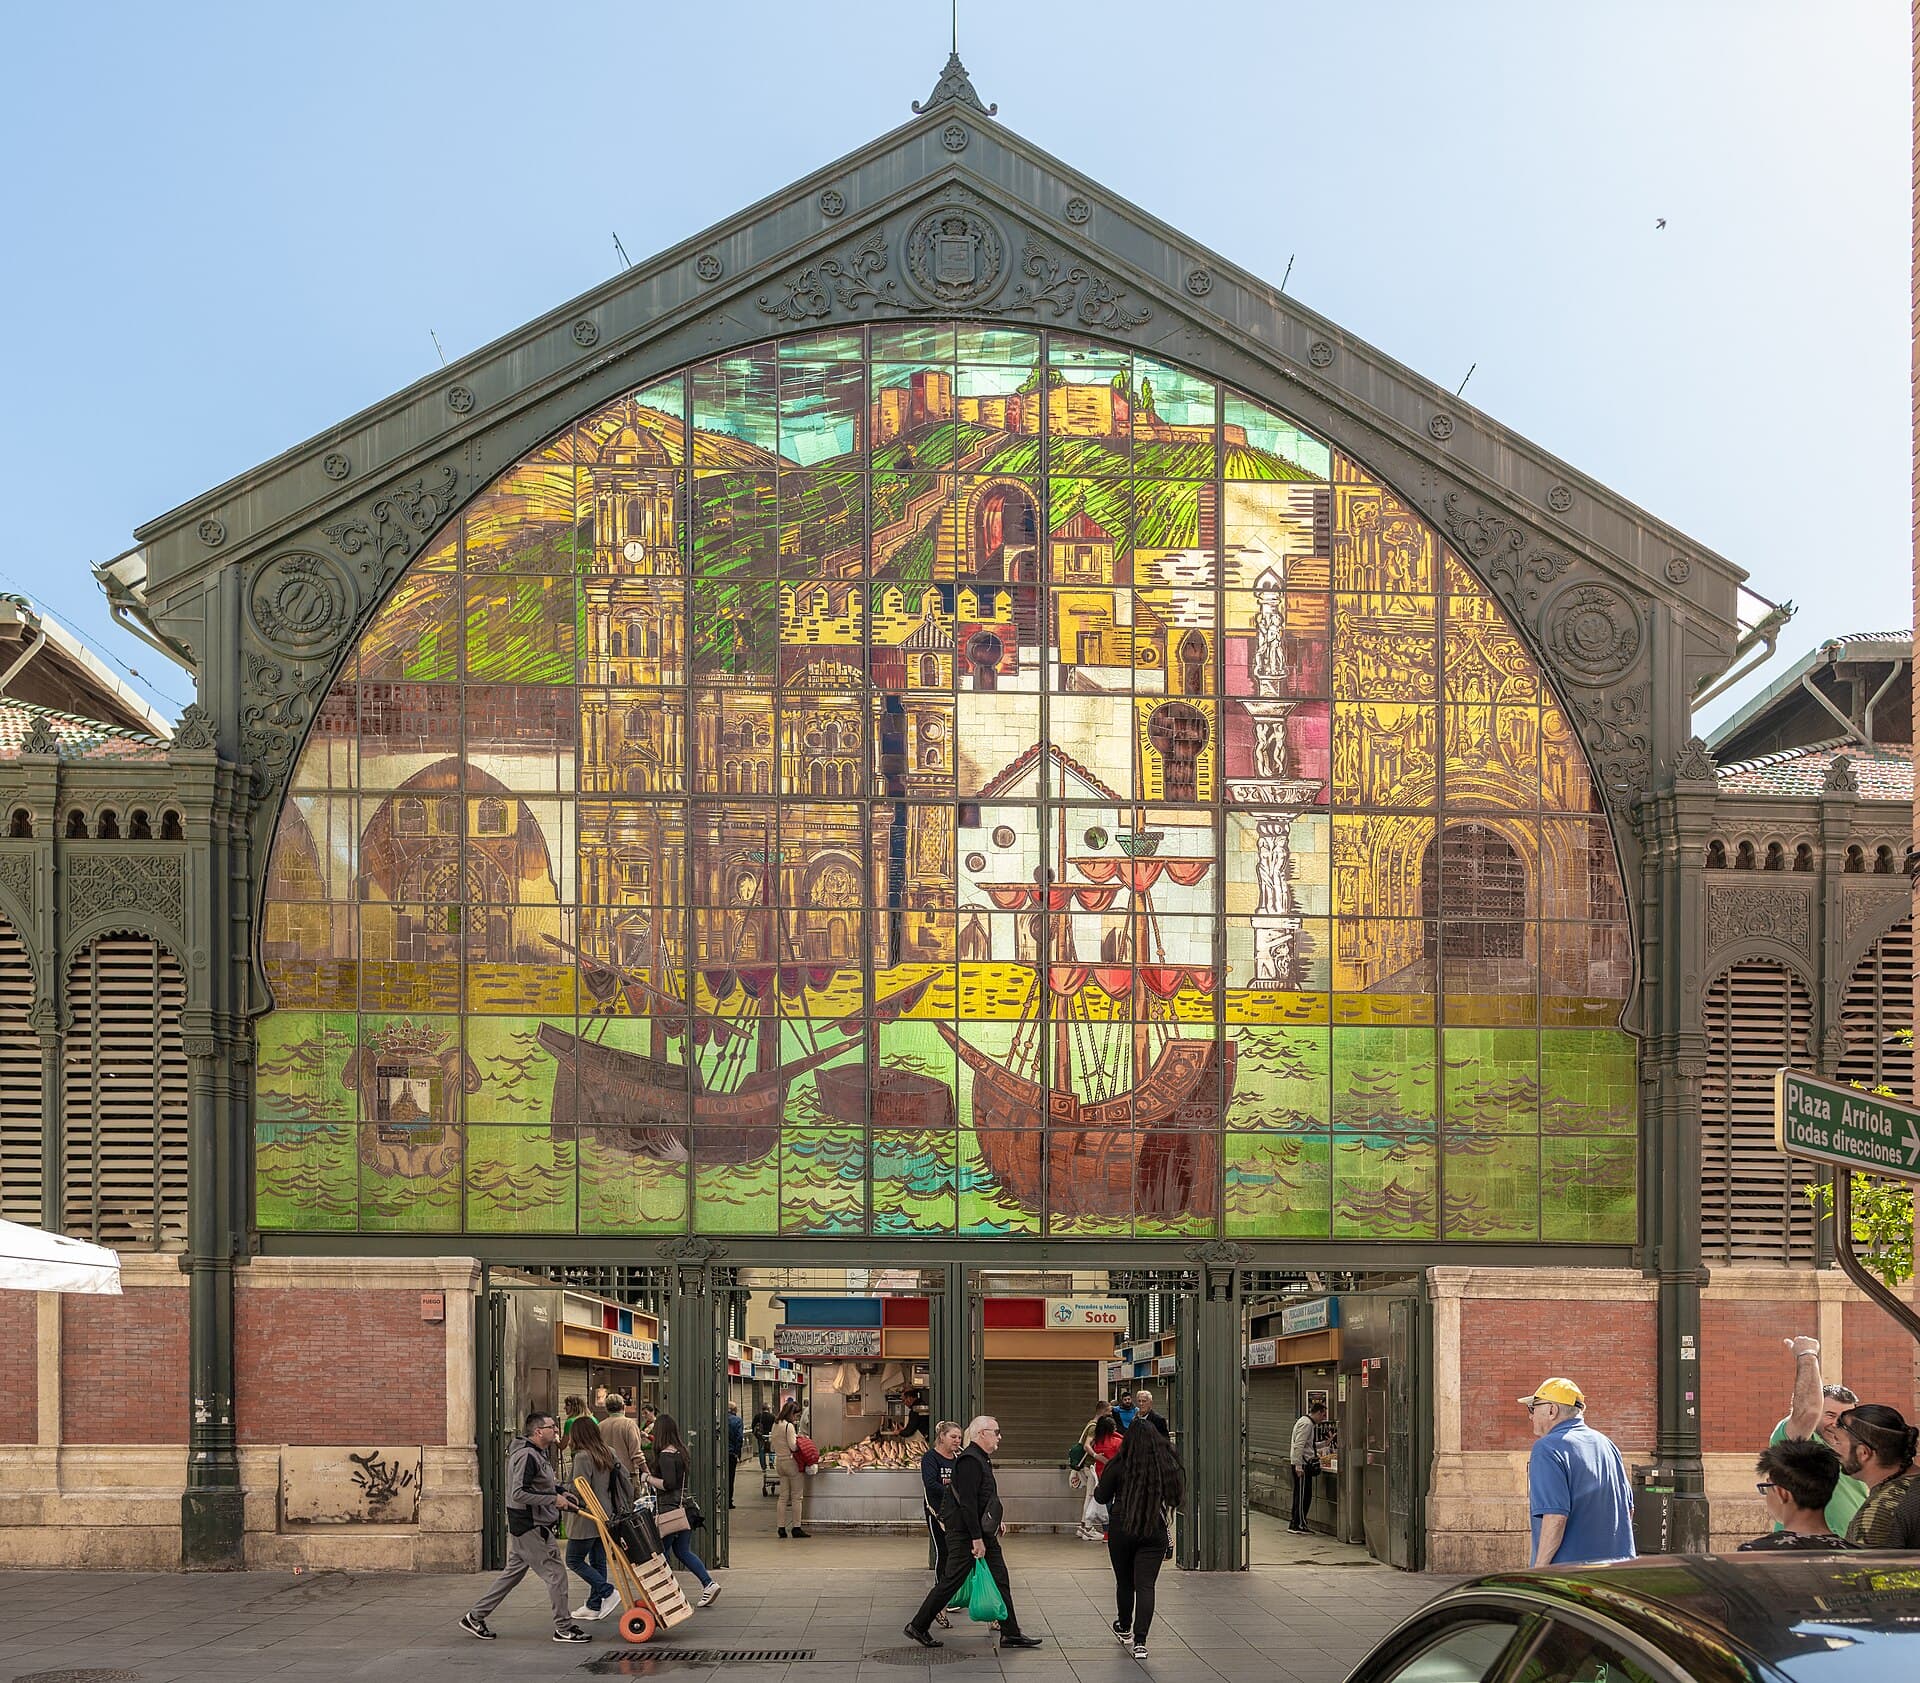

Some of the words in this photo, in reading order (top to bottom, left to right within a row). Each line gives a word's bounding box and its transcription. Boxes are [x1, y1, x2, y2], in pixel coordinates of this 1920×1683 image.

[1788, 1084, 1831, 1120] Plaza
[1841, 1100, 1893, 1137] Arriola
[1788, 1116, 1829, 1147] Todas
[1832, 1129, 1903, 1165] direcciones
[1085, 1311, 1117, 1323] Soto
[781, 1332, 825, 1345] MANUEL
[828, 1332, 873, 1345] BELMAN
